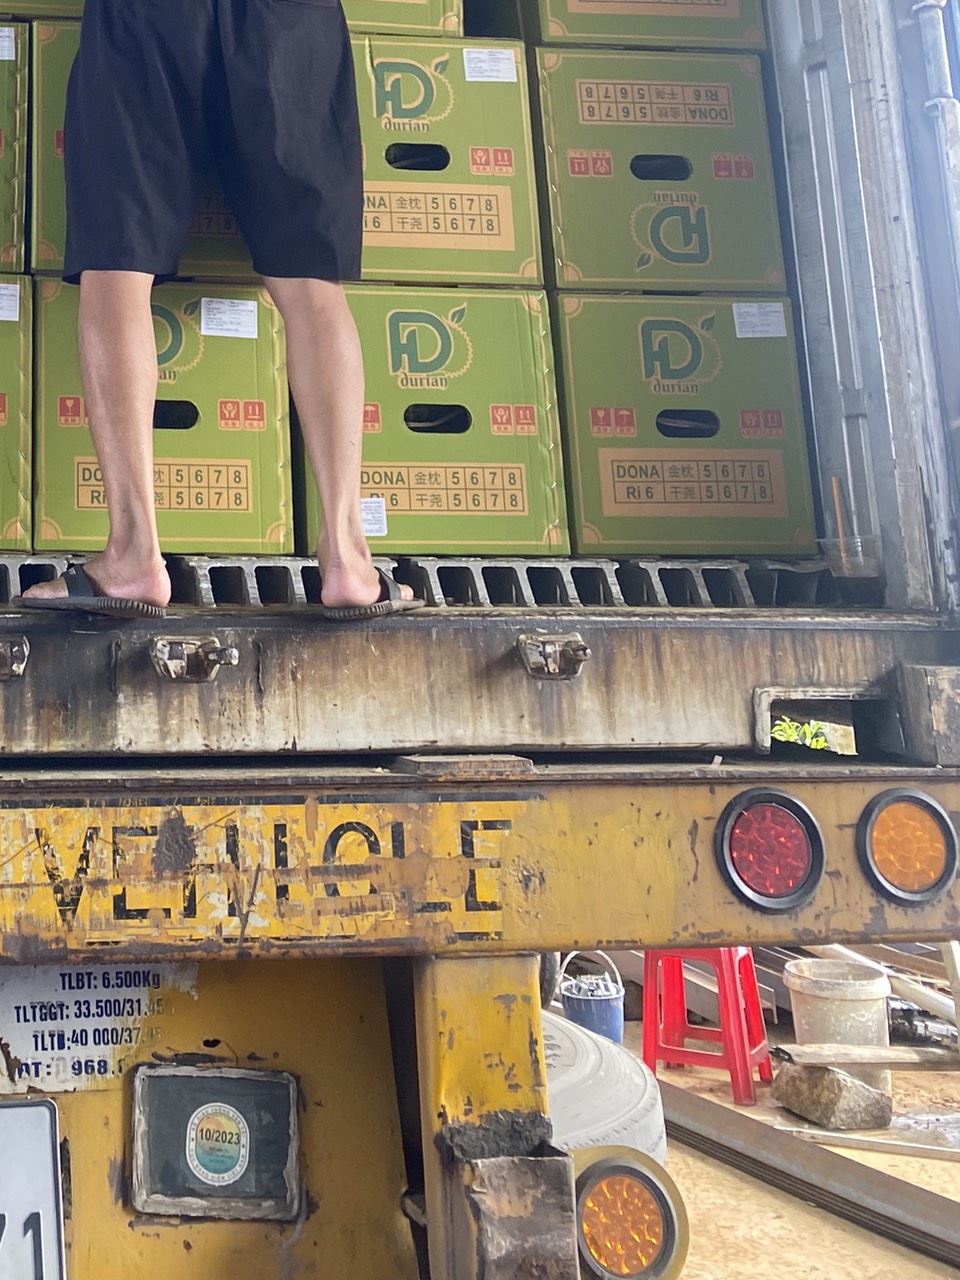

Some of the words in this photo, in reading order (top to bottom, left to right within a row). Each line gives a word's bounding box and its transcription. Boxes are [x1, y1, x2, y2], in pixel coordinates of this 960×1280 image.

[385, 118, 430, 132] durian
[401, 373, 448, 388] durian
[652, 379, 699, 393] durian
[616, 464, 659, 478] DONA
[703, 465, 711, 477] 5
[721, 465, 729, 478] 6
[739, 465, 747, 478] 7
[757, 465, 765, 478] 8
[644, 486, 652, 499] 6
[705, 486, 713, 499] 5
[722, 486, 731, 499] 6
[741, 486, 748, 499] 7
[759, 486, 767, 499] 8
[59, 972, 98, 990] TLBT:
[102, 970, 161, 989] 6.500Kg
[199, 1128, 240, 1145] 10/2023
